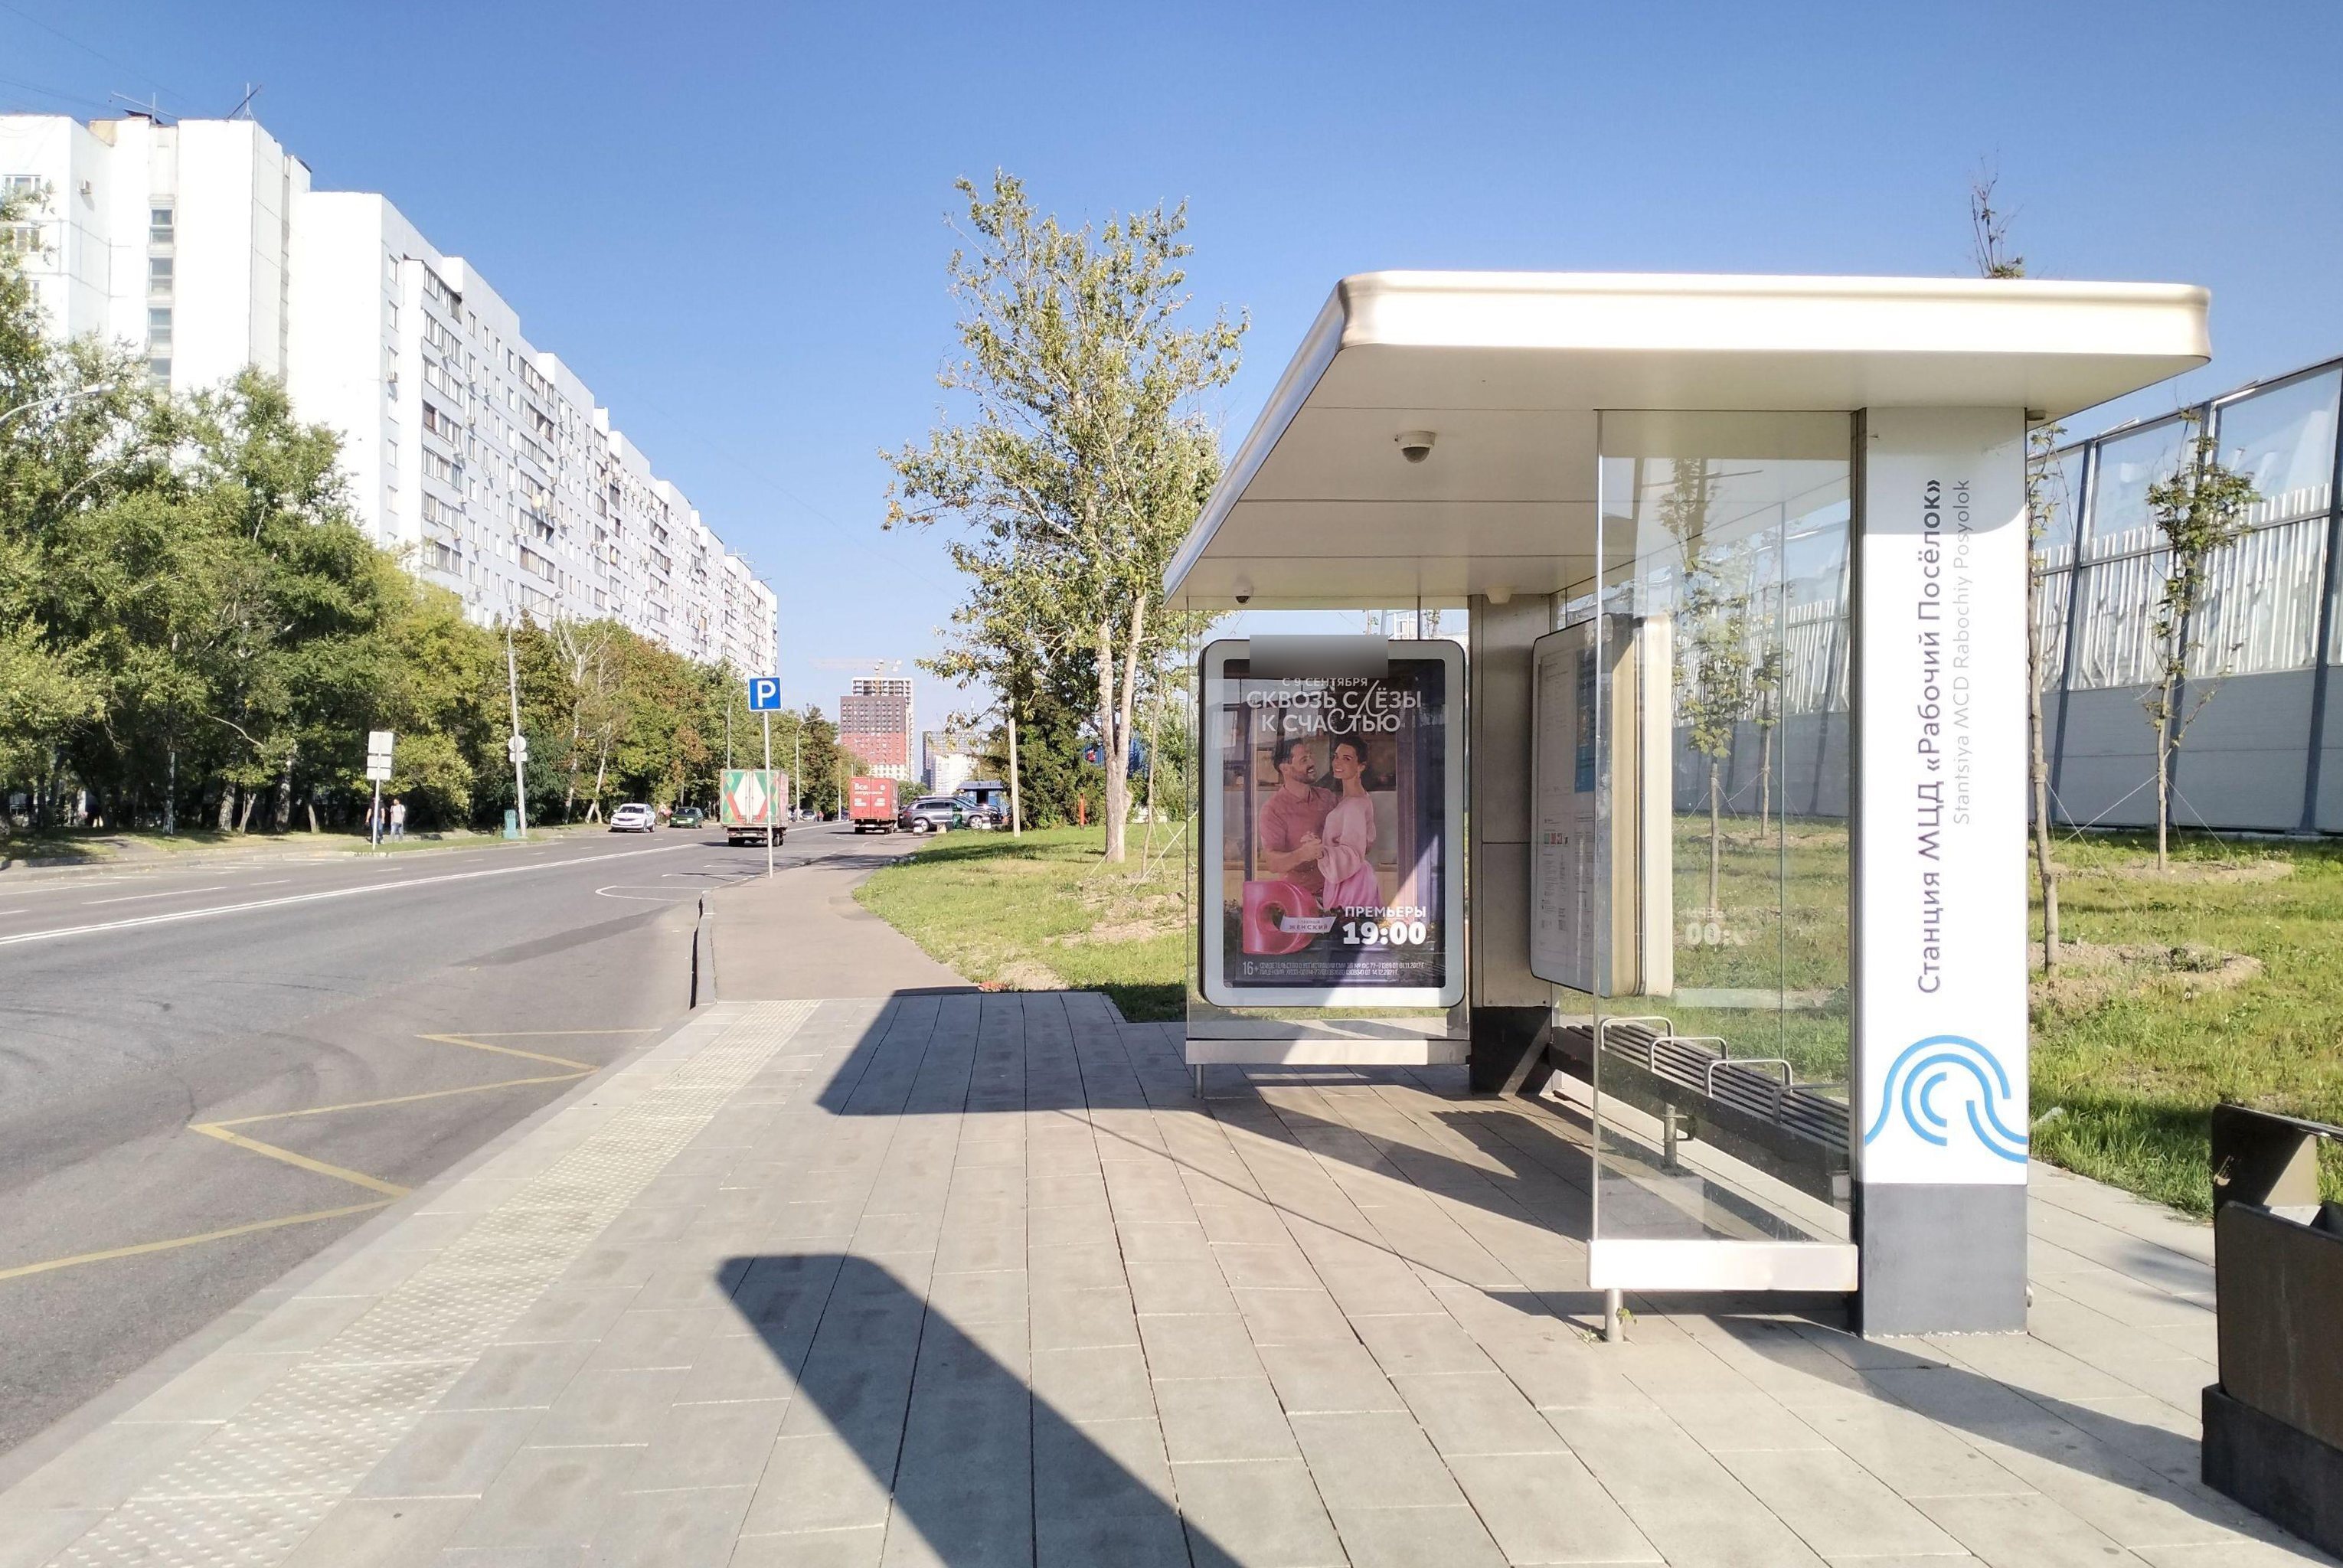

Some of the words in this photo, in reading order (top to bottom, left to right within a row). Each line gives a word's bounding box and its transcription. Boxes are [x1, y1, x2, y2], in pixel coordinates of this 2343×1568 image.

[1917, 479, 1941, 620] Посёлок»
[1952, 479, 1974, 568] Posyolok
[1953, 576, 1973, 668] Rabochiy
[756, 680, 776, 708] P
[1246, 691, 1337, 709] СКВОЗЬ
[1342, 680, 1422, 717] СЛЁЗЫ
[1282, 678, 1291, 687] С
[1294, 678, 1301, 687] 9
[1305, 678, 1368, 688] СЕНТЯБРЯ
[1917, 631, 1941, 772] «Рабочий
[1953, 676, 1970, 729] MCD
[1261, 714, 1277, 732] К
[1283, 708, 1401, 734] СЧАСТЬЮ
[1953, 735, 1973, 825] Stantsiya
[1918, 780, 1945, 861] МЦД
[1341, 921, 1427, 946] 19:00
[1345, 906, 1426, 918] ПРЕМЬЕРЫ
[1918, 871, 1944, 994] Станция
[1243, 962, 1259, 975] 16+
